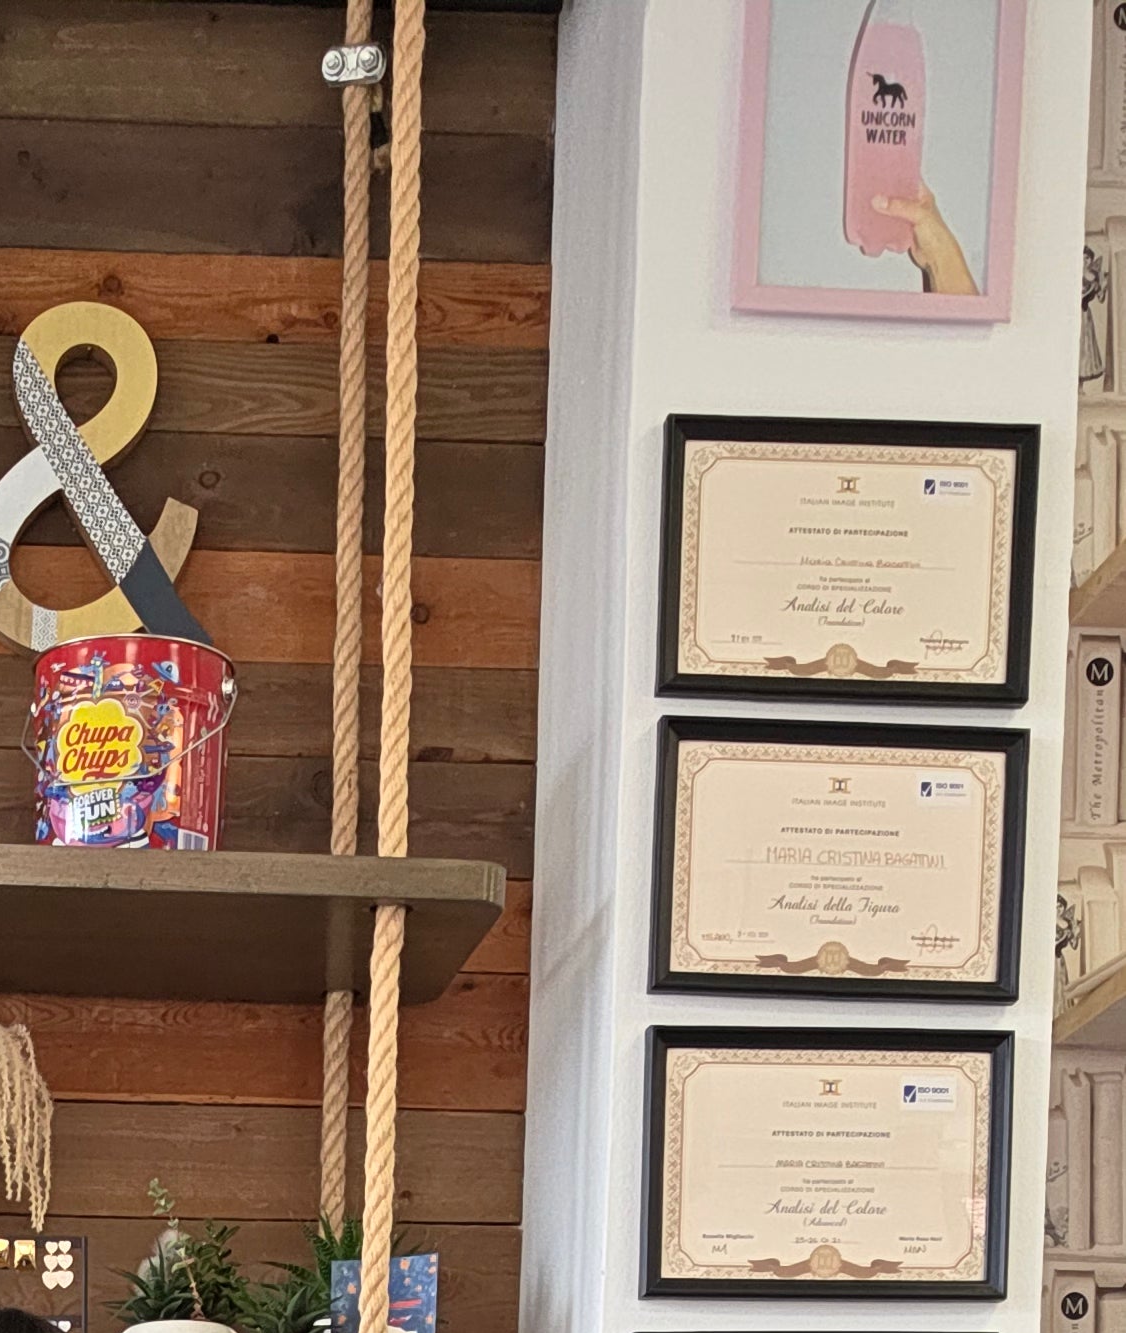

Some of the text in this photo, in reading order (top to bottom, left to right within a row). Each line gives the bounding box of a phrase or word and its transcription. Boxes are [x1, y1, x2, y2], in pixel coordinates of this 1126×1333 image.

[861, 110, 915, 128] UNICORN
[866, 128, 907, 145] WATER
[789, 527, 909, 538] ATTESTATO DI PARTECIPAZIONE
[780, 596, 905, 615] Analisi del Colore
[65, 722, 135, 750] Chupa
[1091, 689, 1109, 786] Metropolitan
[62, 746, 130, 774] Chups
[76, 801, 116, 823] FUN
[781, 827, 823, 835] ATTESTATO
[835, 828, 900, 837] PARTECIPAZIONE
[767, 846, 812, 865] MARIA
[816, 850, 882, 866] CRISTINA
[767, 894, 817, 911] Analisi
[823, 898, 853, 912] della
[772, 1130, 891, 1139] ATTESTATO DI PARTECIPAZIONE
[764, 1199, 887, 1216] Analisi del Colore
